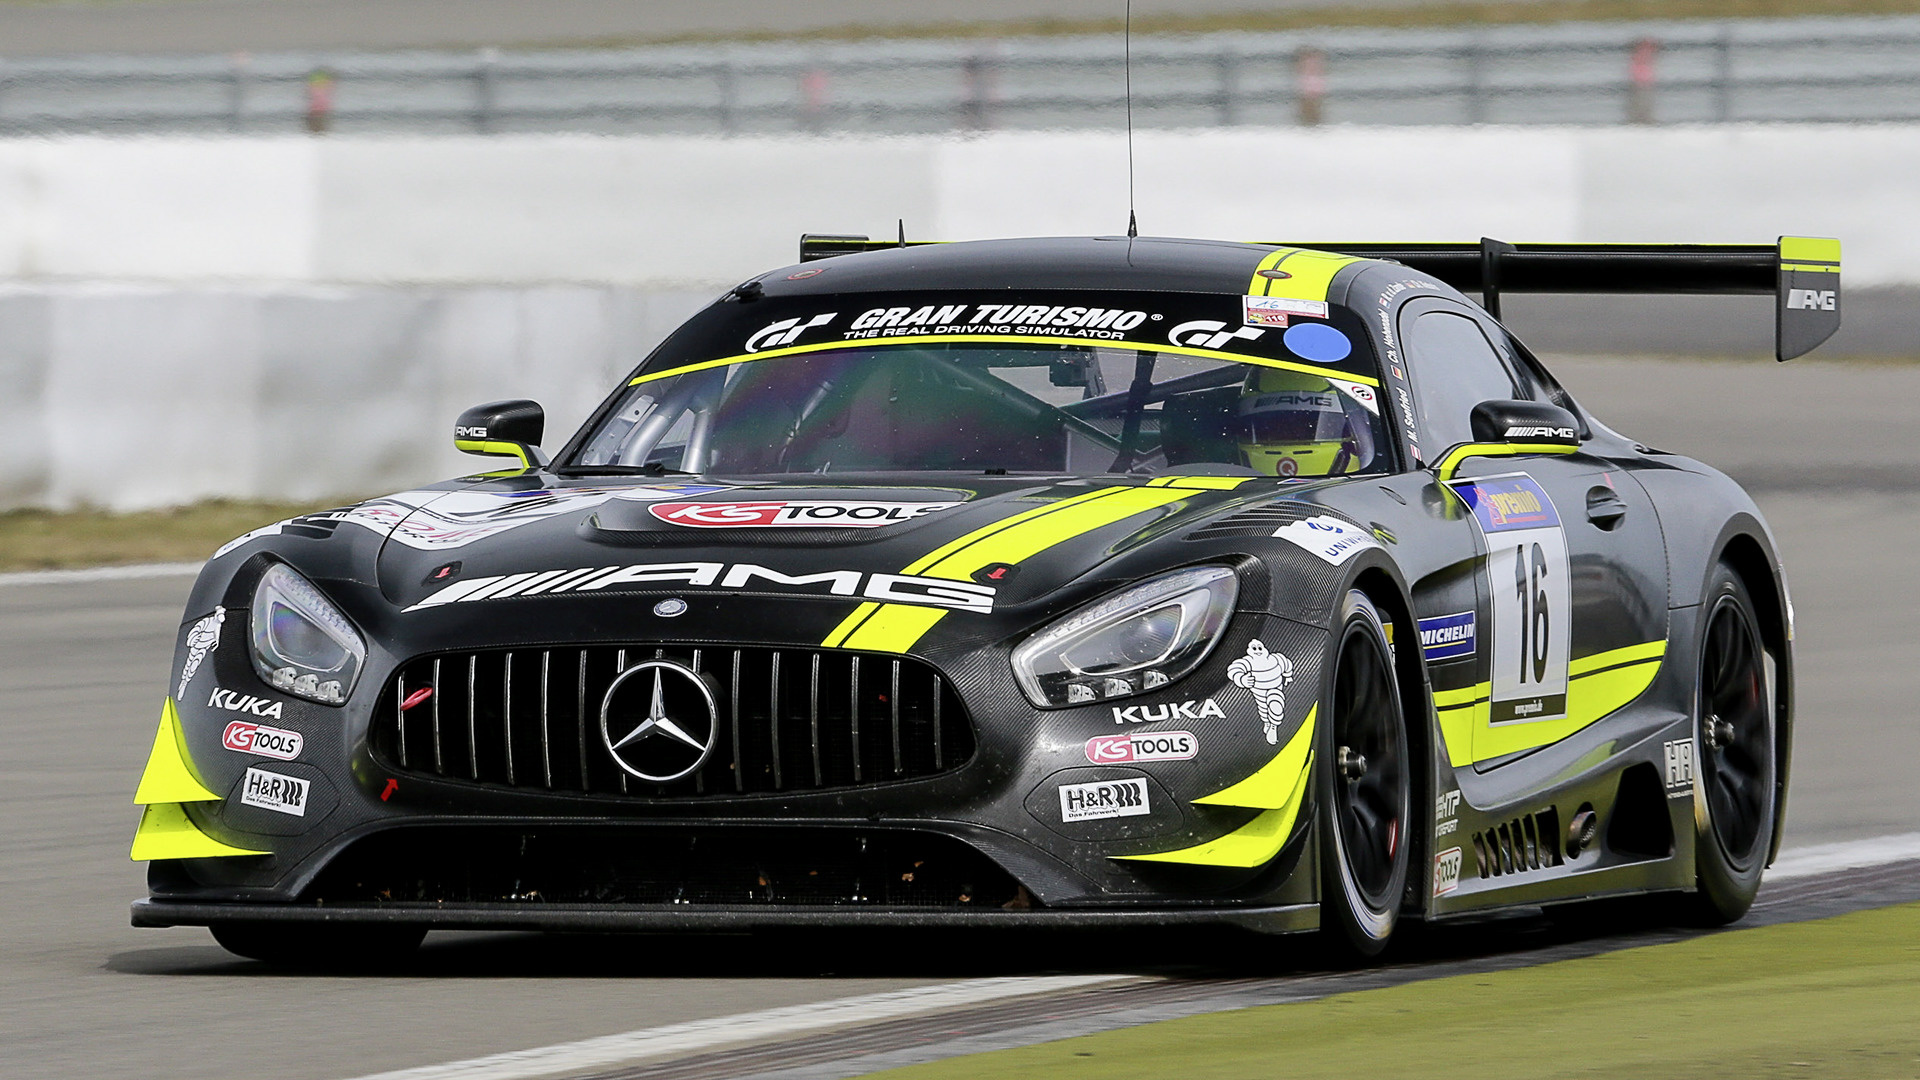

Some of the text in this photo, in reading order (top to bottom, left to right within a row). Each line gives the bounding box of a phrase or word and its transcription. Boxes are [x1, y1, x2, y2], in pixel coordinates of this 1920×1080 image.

[1803, 289, 1836, 311] AMG
[850, 304, 1148, 331] GRAN TURISMO
[843, 324, 1126, 341] THE REAL DRIVING SIMULATOR
[1274, 395, 1332, 408] AMG
[455, 426, 487, 437] AMG
[1531, 426, 1574, 438] AMG
[667, 503, 769, 523] KS
[575, 561, 997, 614] AMG
[1514, 542, 1549, 684] 16
[1420, 623, 1475, 645] MICHELIN
[207, 687, 283, 720] KUKA
[1112, 698, 1227, 725] KUKA
[226, 725, 296, 754] KS TOOLS
[1093, 737, 1190, 760] KS TOOLS
